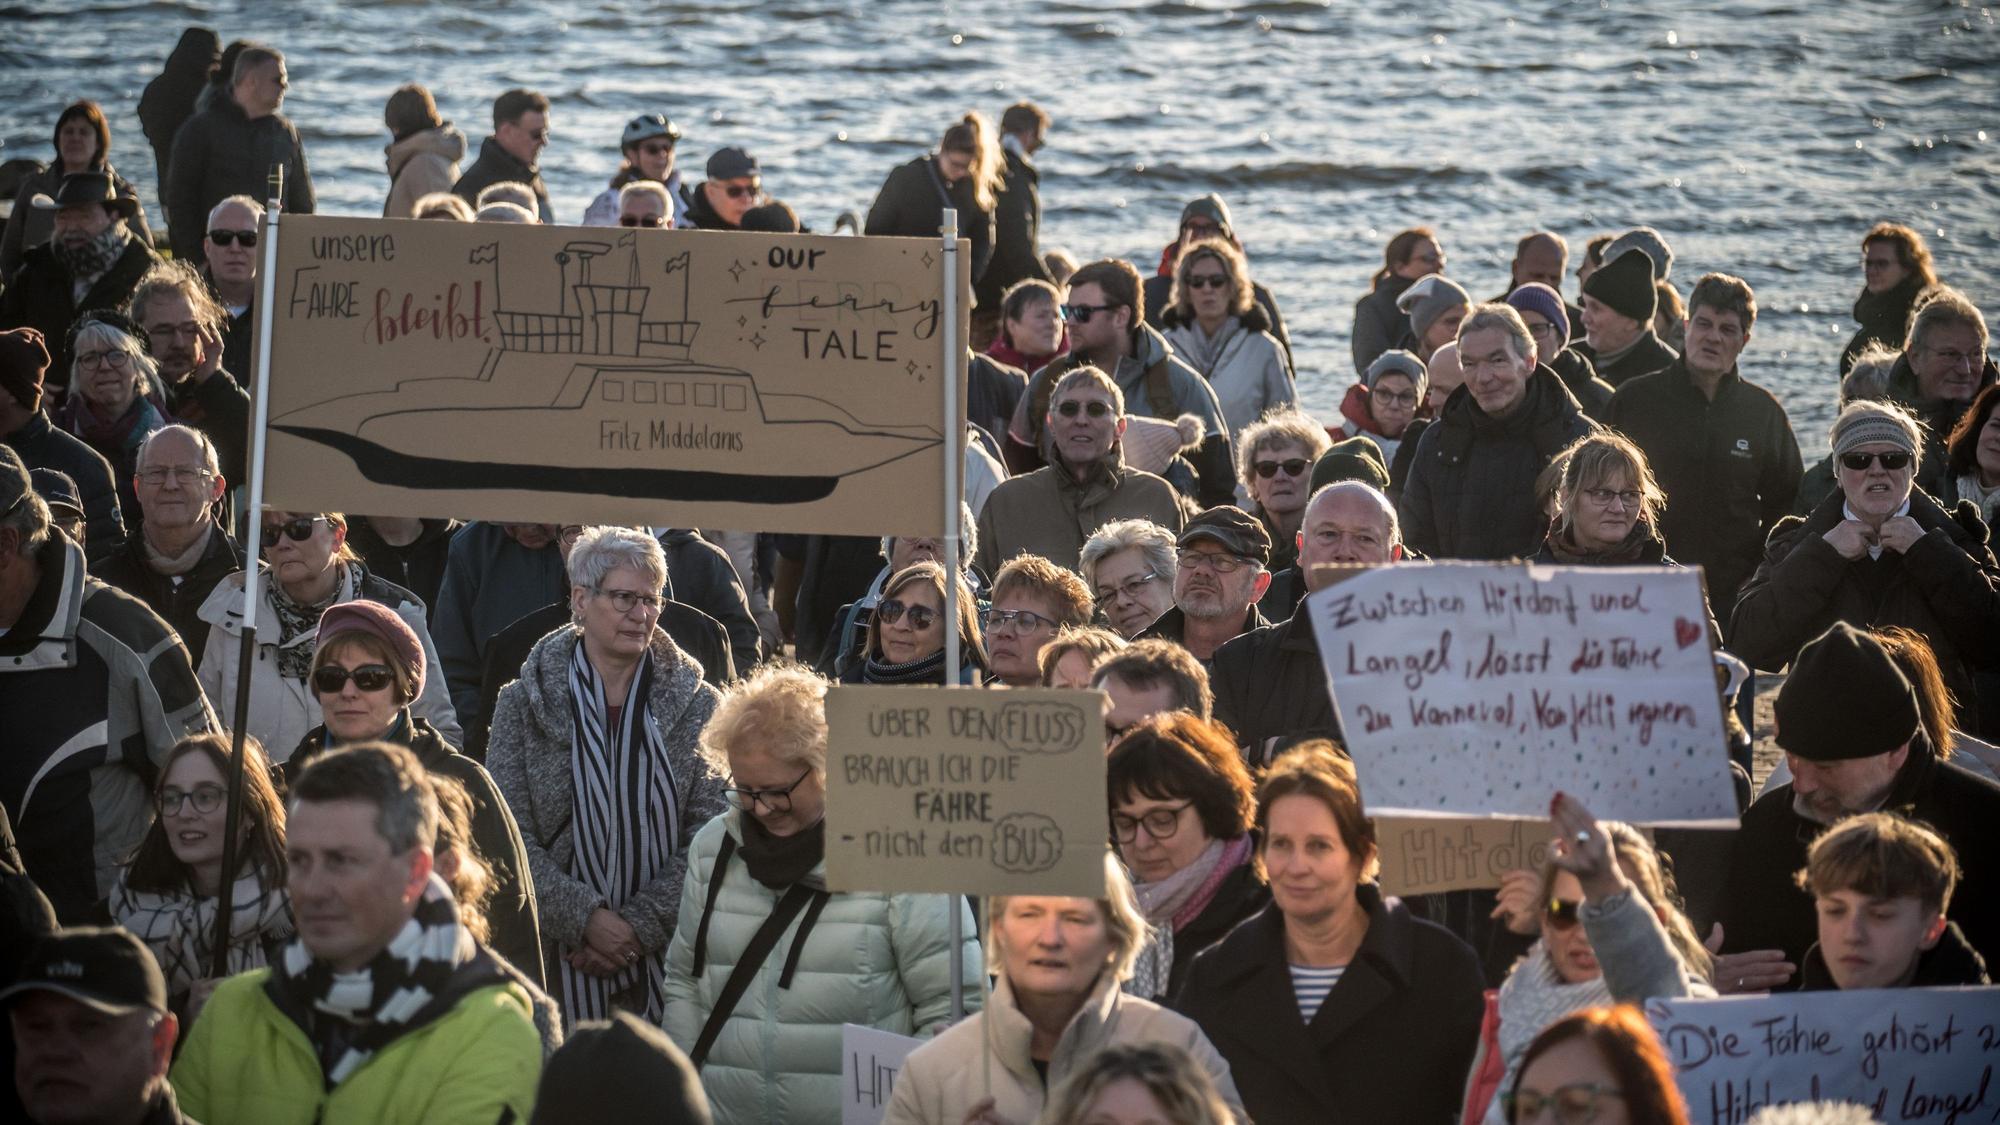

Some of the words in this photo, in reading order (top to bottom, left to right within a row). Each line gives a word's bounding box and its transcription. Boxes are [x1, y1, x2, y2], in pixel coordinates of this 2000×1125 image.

[312, 234, 395, 263] unsere
[768, 246, 826, 271] our
[725, 285, 944, 340] ferry
[792, 327, 898, 362] TALE
[1327, 585, 1465, 629] Zwischen
[1592, 584, 1650, 613] und
[868, 704, 931, 738] ÜBER
[949, 706, 999, 742] DEN
[1006, 709, 1078, 746] FLUSS
[844, 754, 929, 787] BRAUCH
[939, 754, 971, 783] ICH
[981, 755, 1021, 783] DIE
[914, 788, 994, 823] FÄHRE
[865, 826, 927, 858] nicht
[940, 830, 983, 858] den
[1002, 822, 1055, 866] BUS
[1401, 820, 1549, 888] Hitdo
[1666, 1023, 1751, 1072] Die
[1861, 1012, 1964, 1080] gehört
[1977, 1023, 2000, 1052] z
[854, 1051, 898, 1110] HIT
